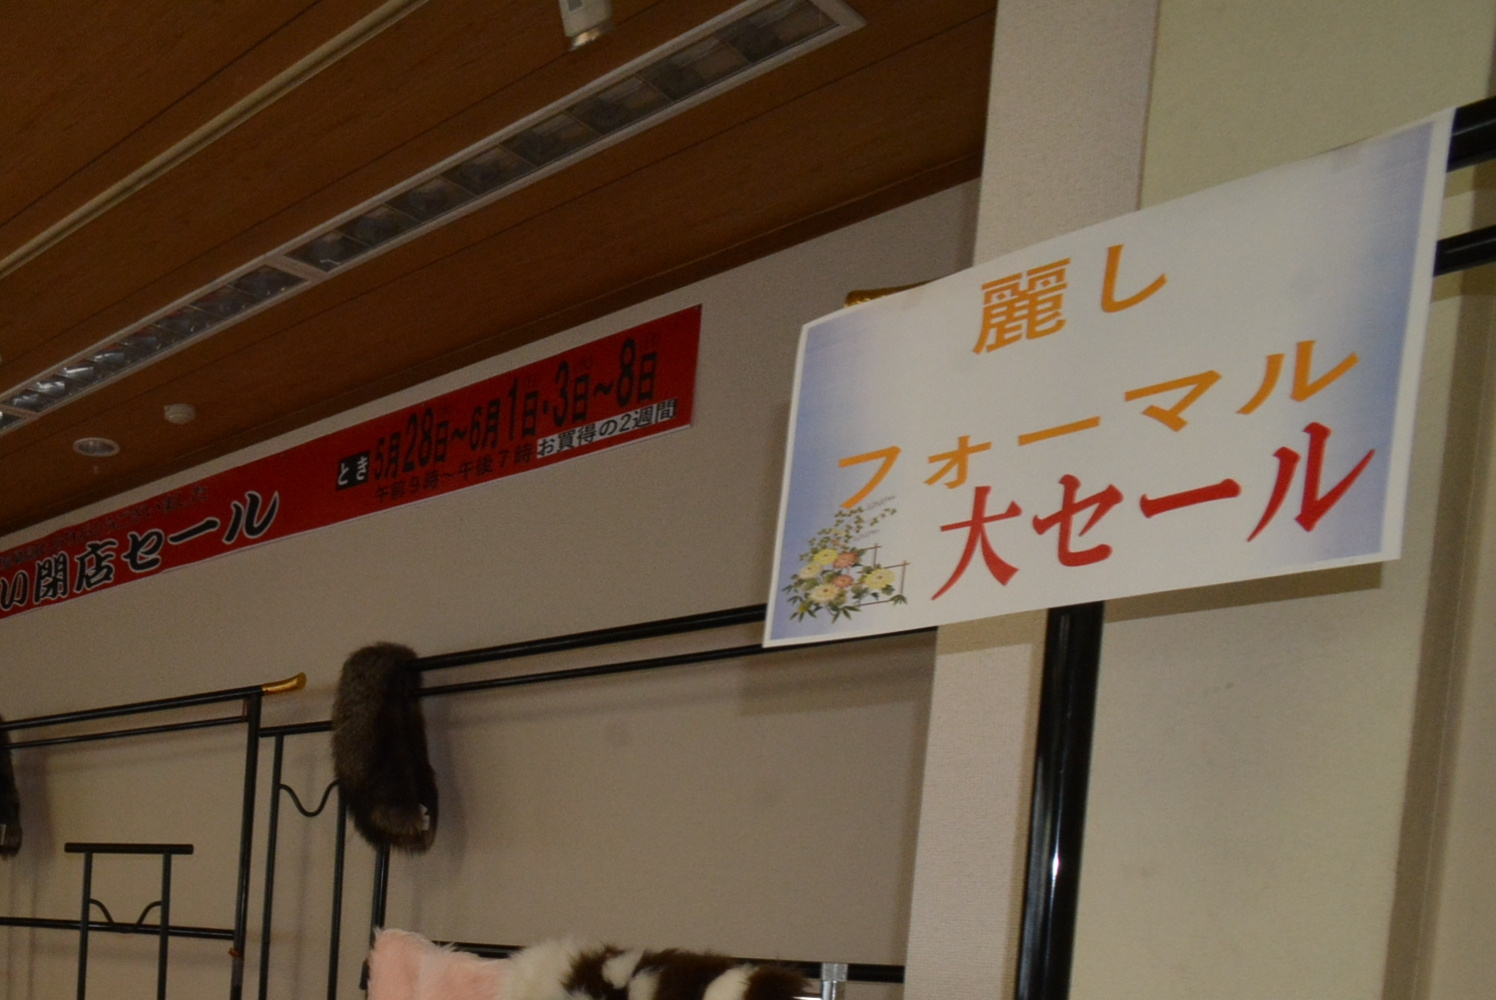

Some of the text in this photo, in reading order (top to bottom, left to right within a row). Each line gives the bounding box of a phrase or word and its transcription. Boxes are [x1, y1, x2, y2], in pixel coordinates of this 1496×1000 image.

[971, 243, 1168, 356] 麗し
[336, 457, 369, 487] とき
[538, 398, 677, 456] お買得の2週間
[837, 339, 1359, 509] フォーマル
[931, 421, 1376, 601] 大セール
